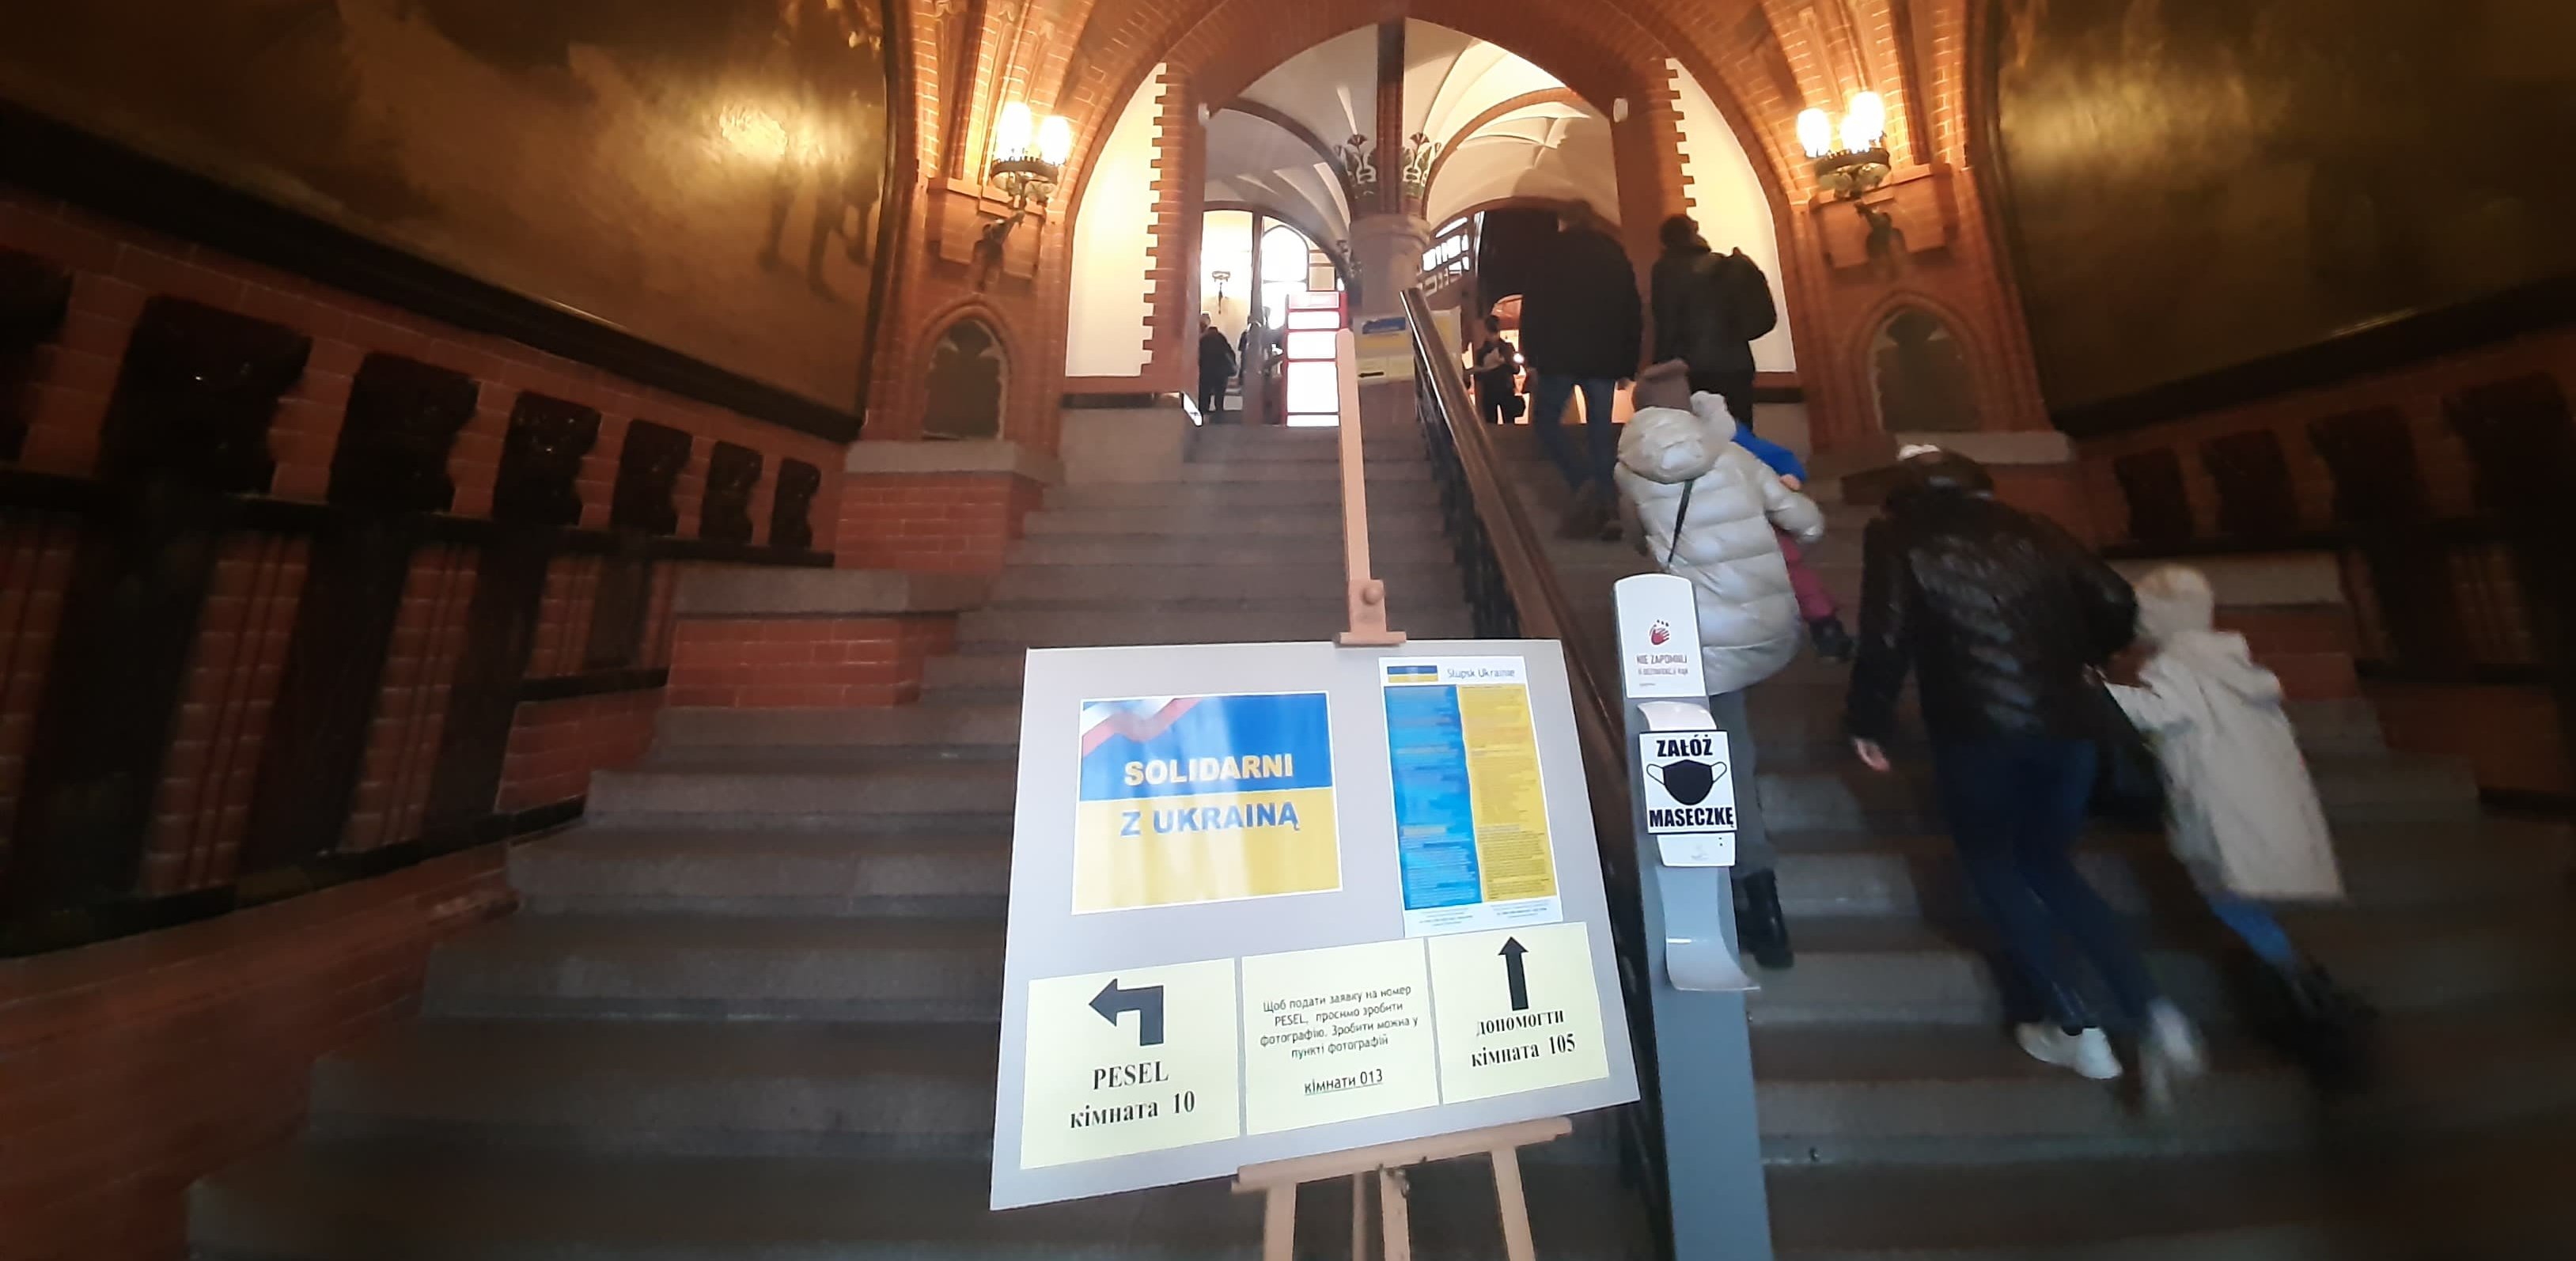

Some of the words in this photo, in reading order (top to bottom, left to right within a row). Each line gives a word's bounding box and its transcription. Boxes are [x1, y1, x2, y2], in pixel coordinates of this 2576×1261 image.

[1656, 734, 1713, 757] ZAŁÓŻ
[1124, 753, 1294, 786] SOLIDARNI
[1120, 809, 1142, 837] Z
[1154, 801, 1301, 834] UKRAINĄ
[1649, 807, 1734, 828] MASECZKĘ
[1263, 999, 1286, 1013] Щоб
[1290, 997, 1326, 1009] подати
[1330, 991, 1362, 1004] заявку
[1366, 990, 1377, 999] на
[1381, 986, 1411, 998] номер
[1316, 1008, 1360, 1023] просимо
[1362, 1002, 1404, 1017] зробити
[1332, 1022, 1373, 1036] Зробити
[1377, 1017, 1410, 1030] можна
[1412, 1017, 1419, 1027] у
[1476, 1010, 1564, 1036] допомогти
[1291, 1043, 1324, 1060] пункті
[1328, 1034, 1388, 1055] фотографій
[1472, 1047, 1540, 1067] кімната
[1549, 1033, 1575, 1055] 105
[1093, 1061, 1169, 1090] PESEL
[1305, 1074, 1356, 1095] кімнати
[1360, 1068, 1383, 1085] 013
[1070, 1104, 1158, 1128] кімната
[1174, 1090, 1195, 1114] 10
